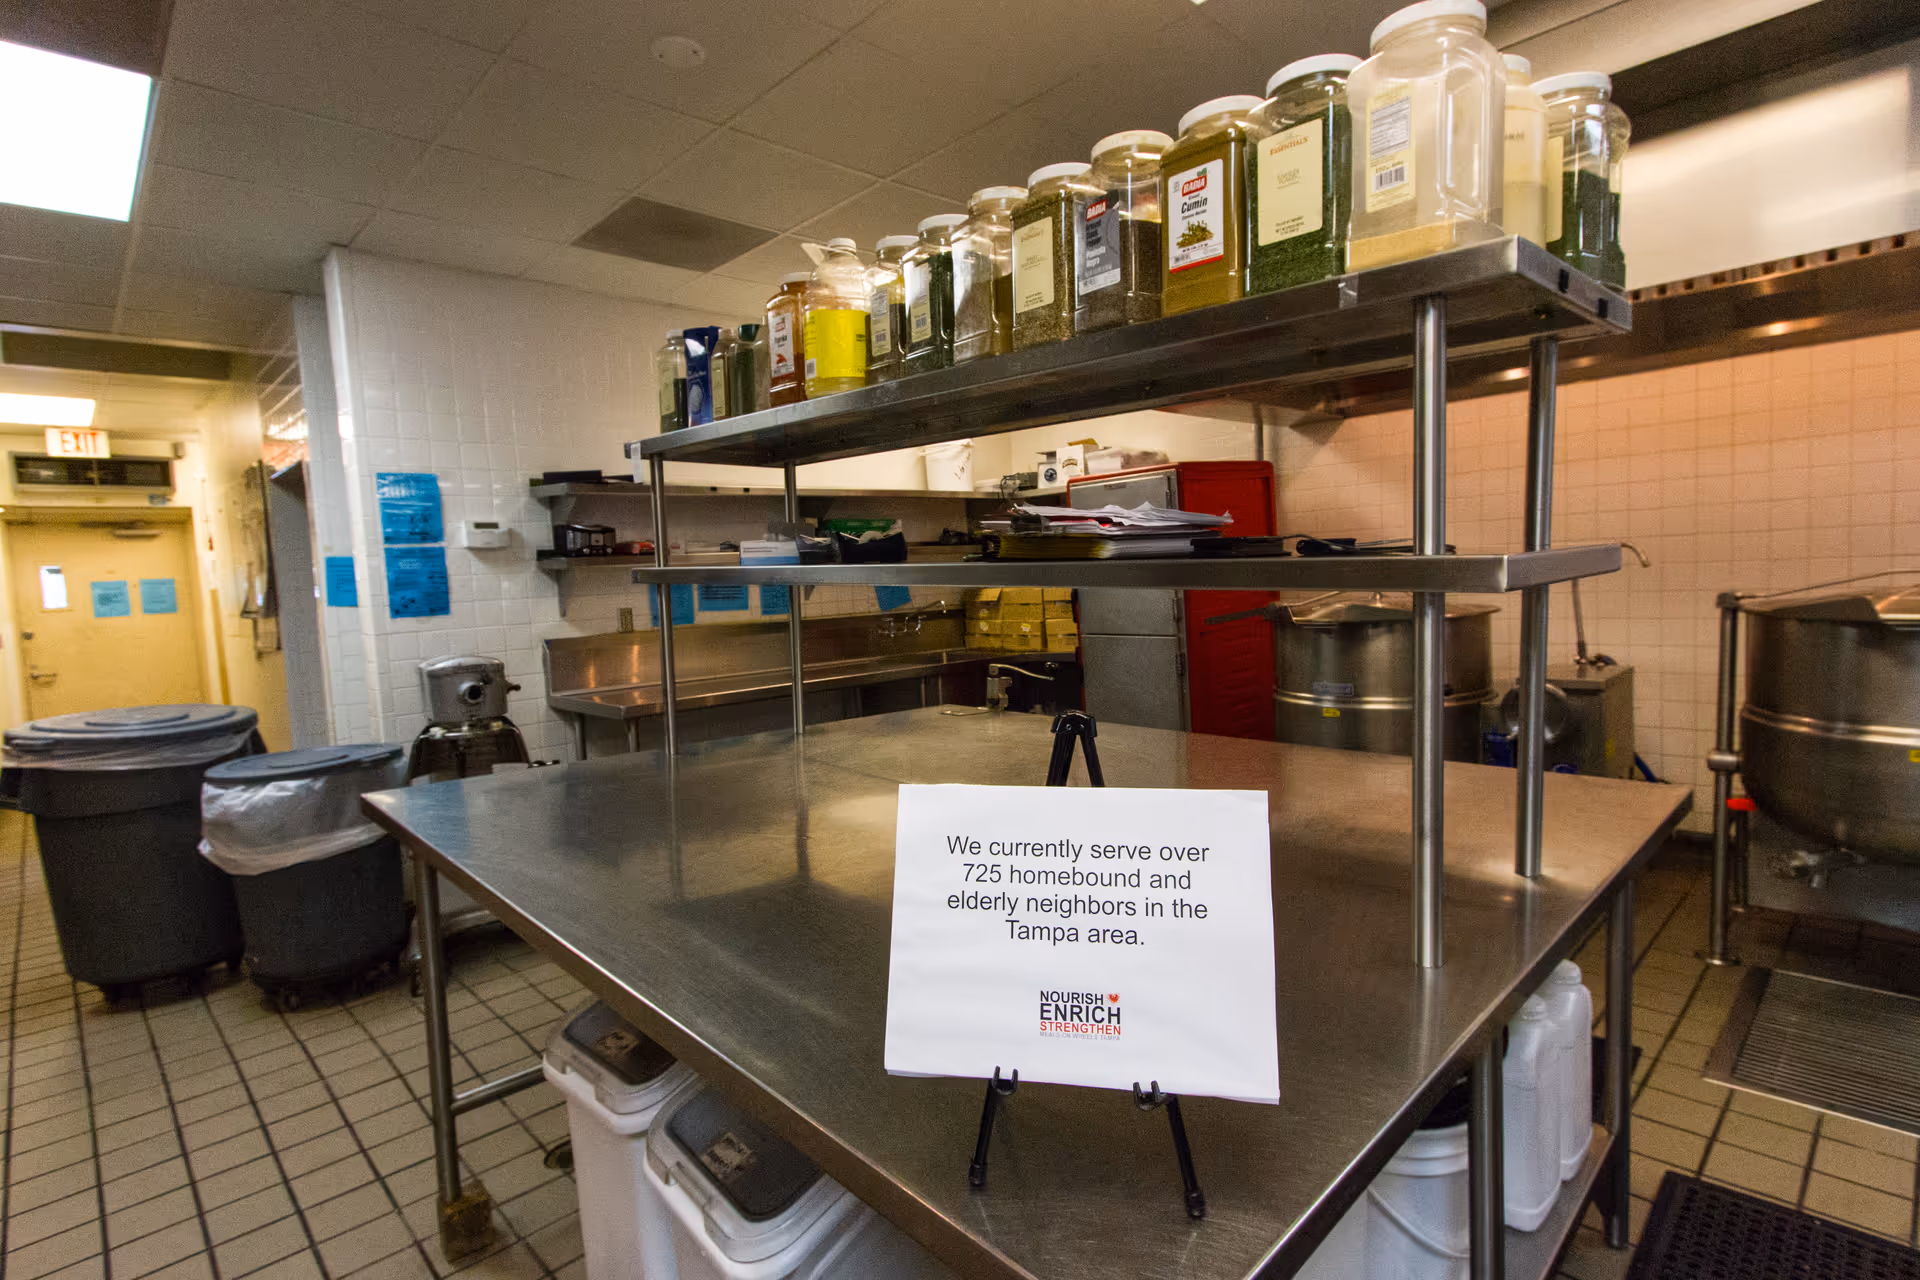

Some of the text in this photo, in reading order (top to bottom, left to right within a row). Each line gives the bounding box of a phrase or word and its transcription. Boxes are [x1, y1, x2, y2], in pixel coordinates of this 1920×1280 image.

[1183, 180, 1206, 195] BADIA
[1086, 201, 1107, 219] BADIA
[1181, 196, 1208, 214] Cumin
[61, 430, 97, 454] EXIT
[946, 835, 1210, 863] We currently serve over
[963, 863, 1191, 890] 725 homebound and
[947, 890, 1208, 919] elderly neighbors in the
[1005, 919, 1144, 947] Tampa area.
[1040, 990, 1104, 1006] NOURISH
[1040, 1002, 1121, 1025] ENRICH
[1040, 1021, 1121, 1036] STRENGTHEN
